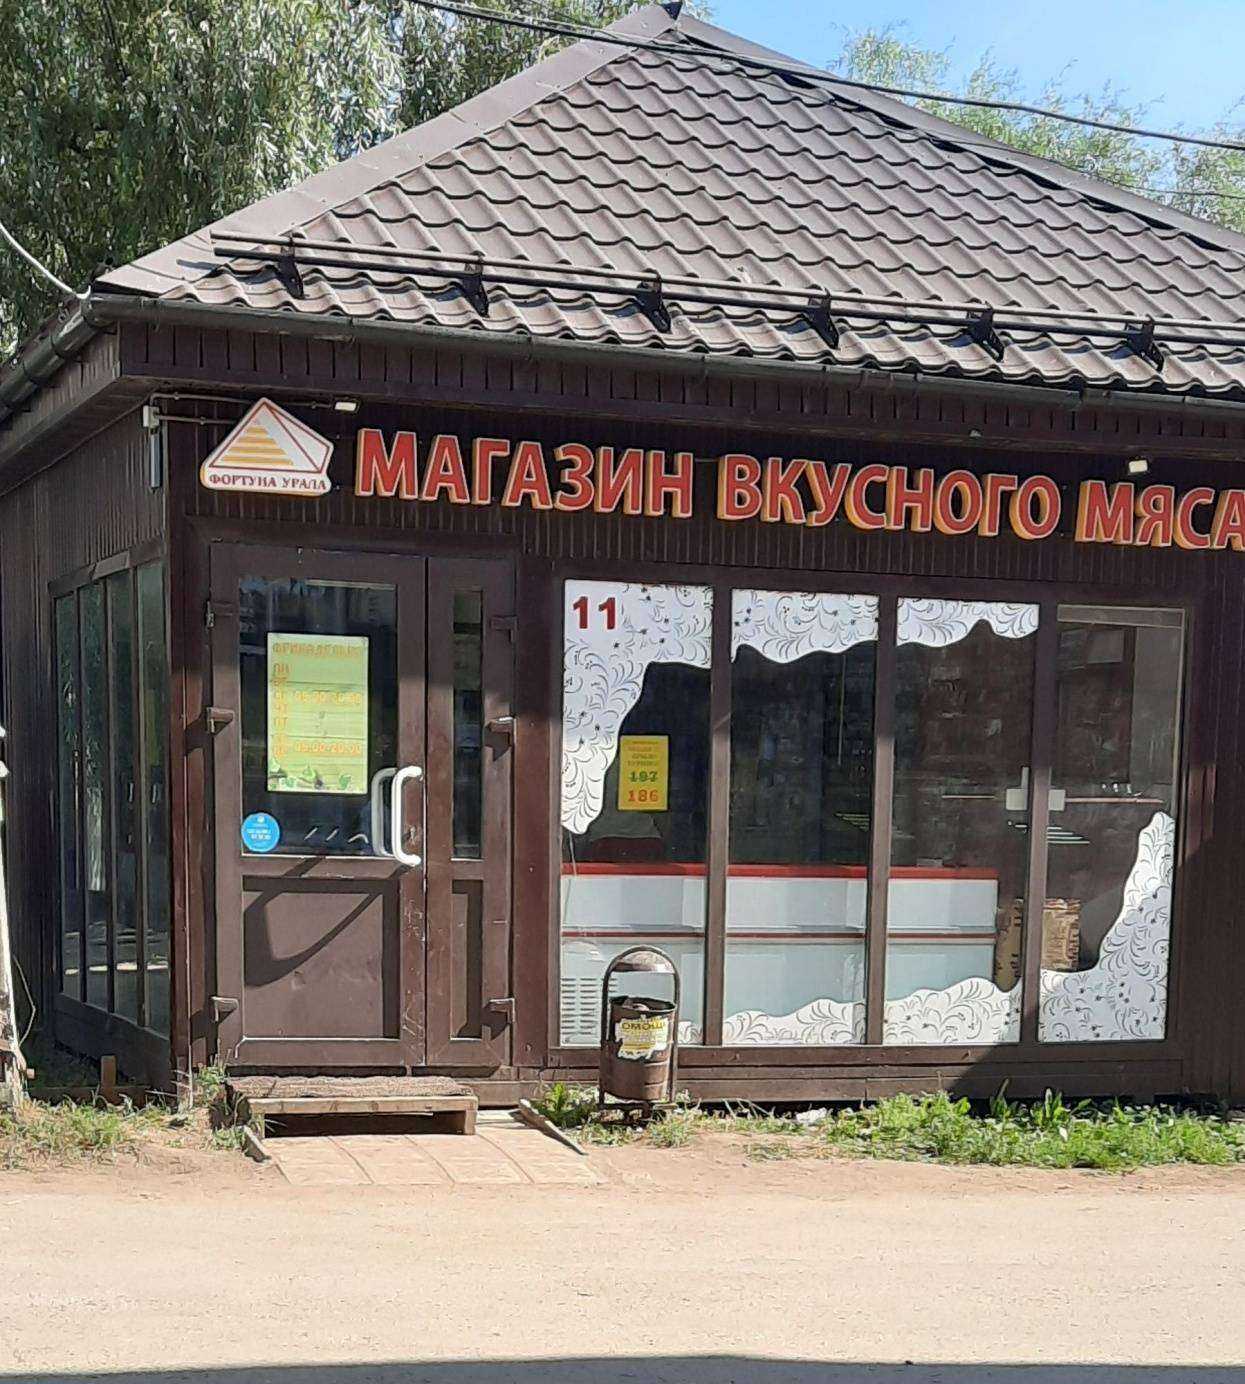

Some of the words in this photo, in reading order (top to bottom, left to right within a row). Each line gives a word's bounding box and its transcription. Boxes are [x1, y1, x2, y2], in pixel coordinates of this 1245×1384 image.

[209, 474, 277, 488] ФОРТУНА
[282, 477, 327, 490] УРАЛА
[356, 428, 694, 518] МАГАЗИН
[717, 454, 1061, 540] ВКУСНОГО
[1075, 479, 1245, 551] МЯСА
[573, 596, 615, 630] 11
[628, 789, 658, 802] 186
